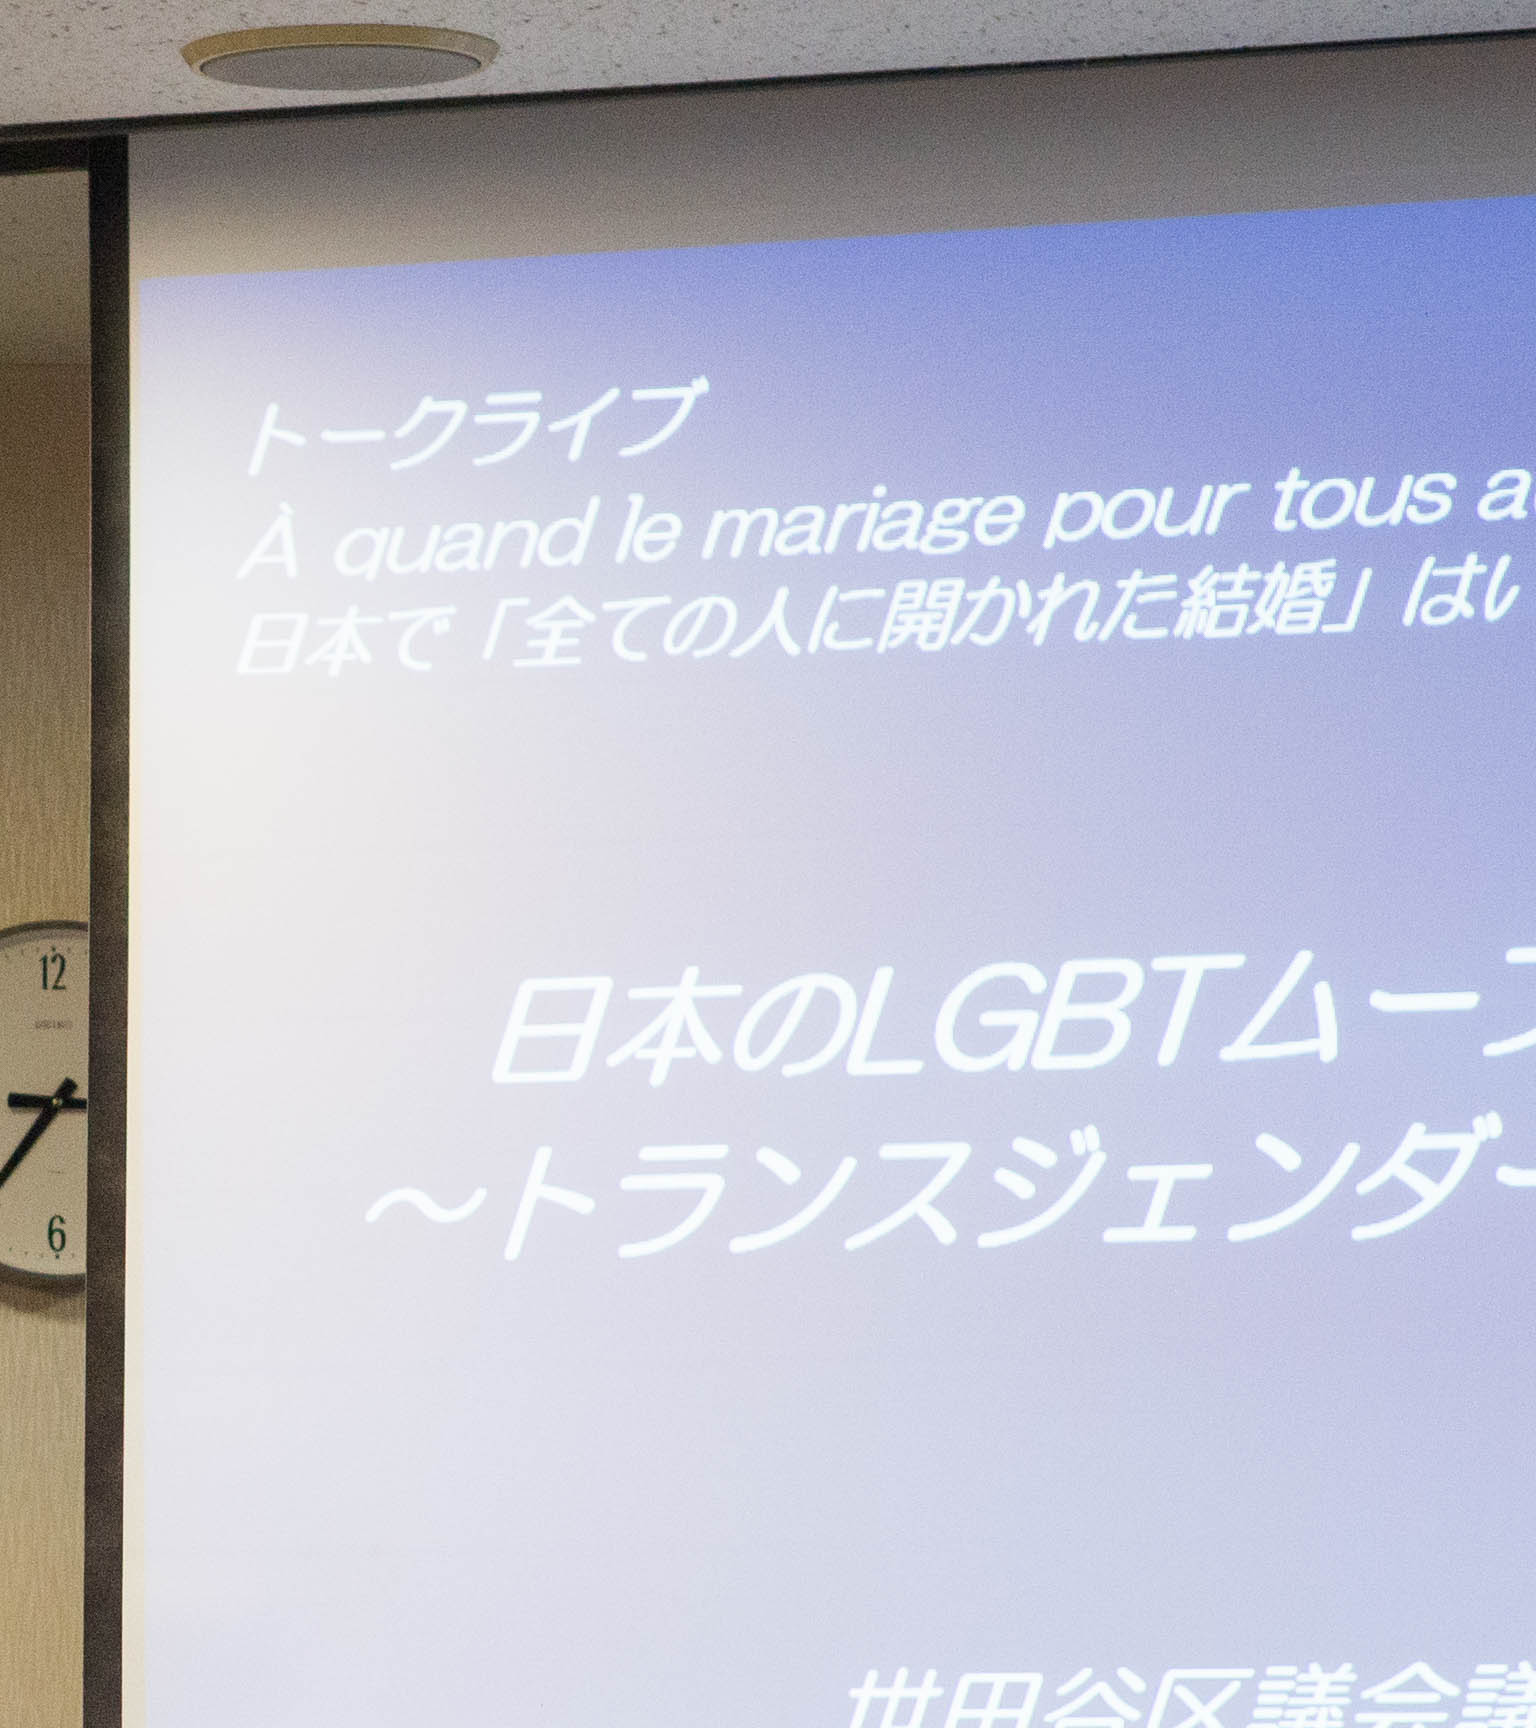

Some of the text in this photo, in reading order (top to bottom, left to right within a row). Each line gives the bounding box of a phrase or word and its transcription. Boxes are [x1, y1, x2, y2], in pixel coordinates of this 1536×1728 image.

[248, 375, 710, 477] トークライブ
[236, 467, 1536, 581] À quand le mariage pour tous a
[39, 951, 67, 990] 12
[47, 1214, 67, 1252] 6
